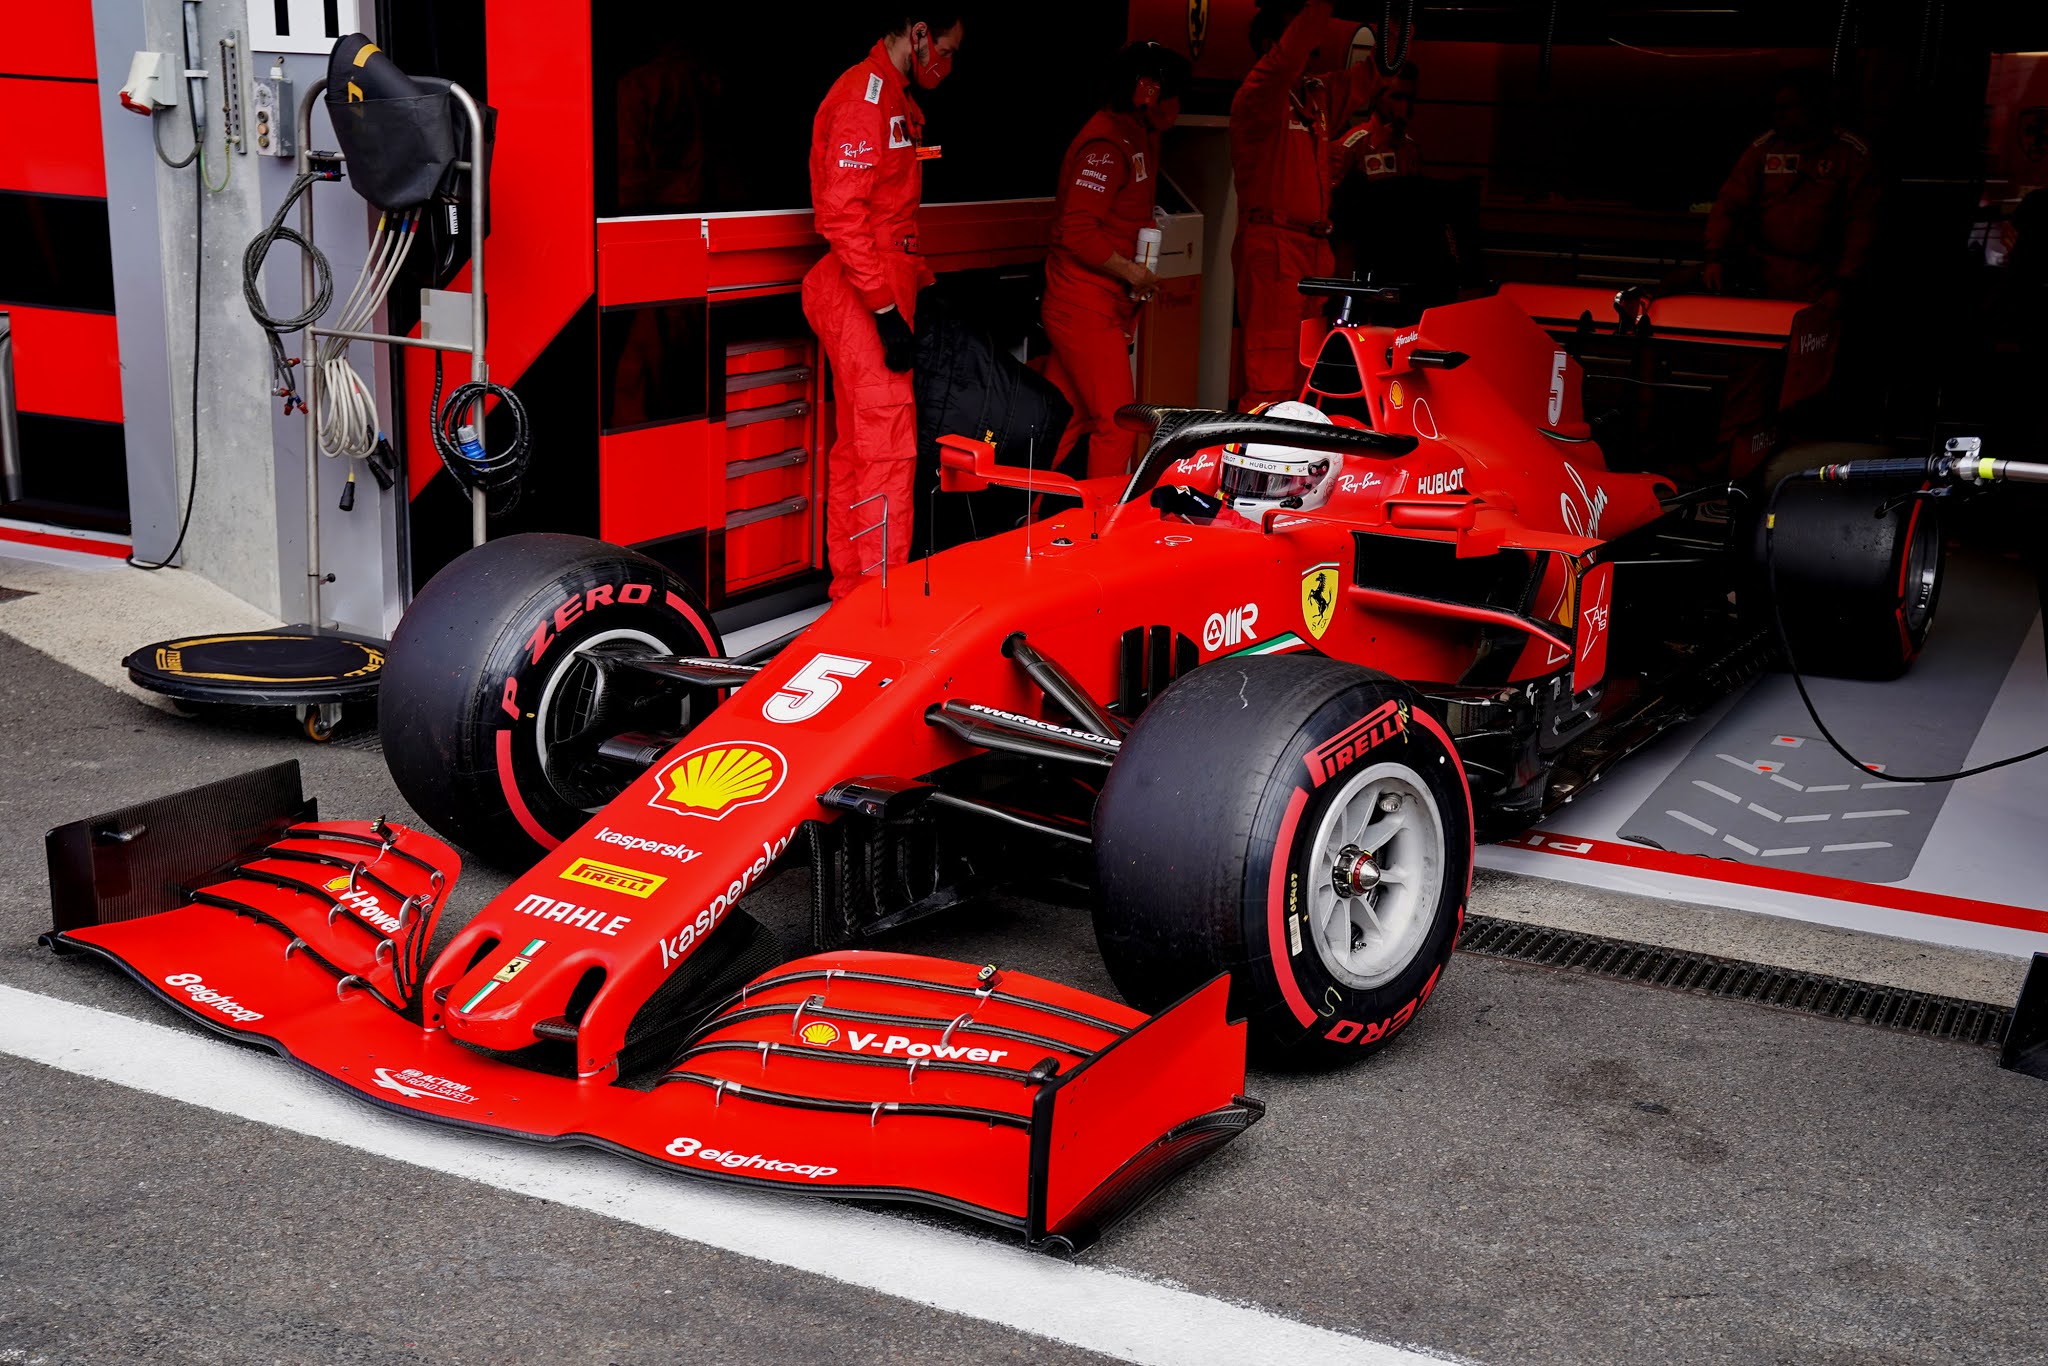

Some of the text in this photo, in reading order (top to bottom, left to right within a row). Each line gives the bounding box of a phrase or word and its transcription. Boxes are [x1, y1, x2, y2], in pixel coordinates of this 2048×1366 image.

[839, 140, 874, 158] Ray-Ban
[1081, 169, 1108, 182] MAHLE
[1547, 350, 1567, 427] 5
[1175, 453, 1215, 475] Ray-Ban
[1249, 461, 1277, 471] HUBLOT
[1417, 466, 1465, 495] HUBLOT
[1337, 471, 1382, 492] Ray-Ban
[524, 583, 653, 665] ZERO
[762, 652, 873, 724] 5
[969, 703, 1123, 747] #WeRaceAsOne
[1302, 699, 1405, 789] PIRELLI
[594, 827, 703, 863] kaspersky
[573, 861, 656, 894] PIRELLI
[339, 889, 402, 934] V-Power
[659, 824, 798, 970] kaspersky
[514, 894, 632, 937] MAHLE
[847, 1030, 1009, 1064] V-Power
[407, 1078, 439, 1090] ROAD
[435, 1086, 480, 1103] SAFETY
[419, 1074, 472, 1093] ACTION
[698, 1146, 838, 1179] eightcap
